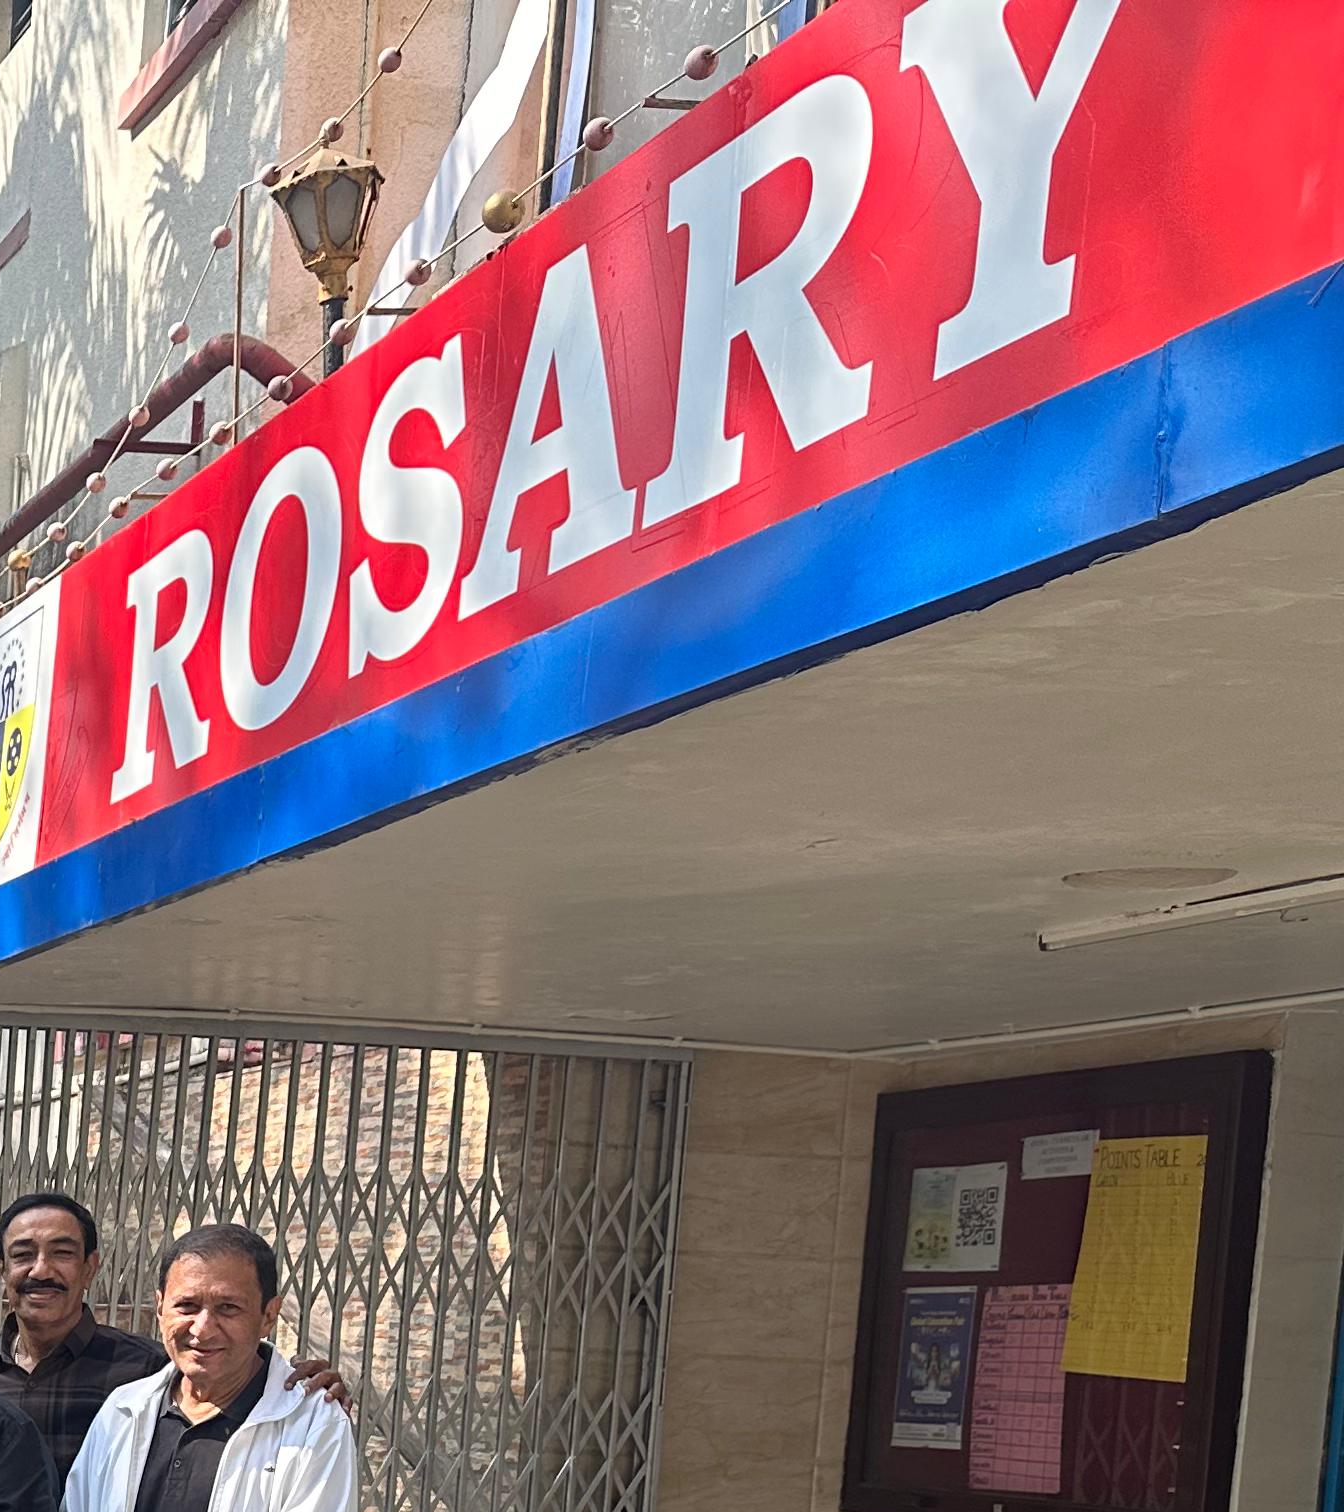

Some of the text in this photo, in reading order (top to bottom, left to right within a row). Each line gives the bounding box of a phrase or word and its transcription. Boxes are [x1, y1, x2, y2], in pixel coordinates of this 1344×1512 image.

[111, 0, 1122, 804] ROSARY
[1100, 1146, 1142, 1169] POINTS
[1144, 1143, 1182, 1168] TABLE
